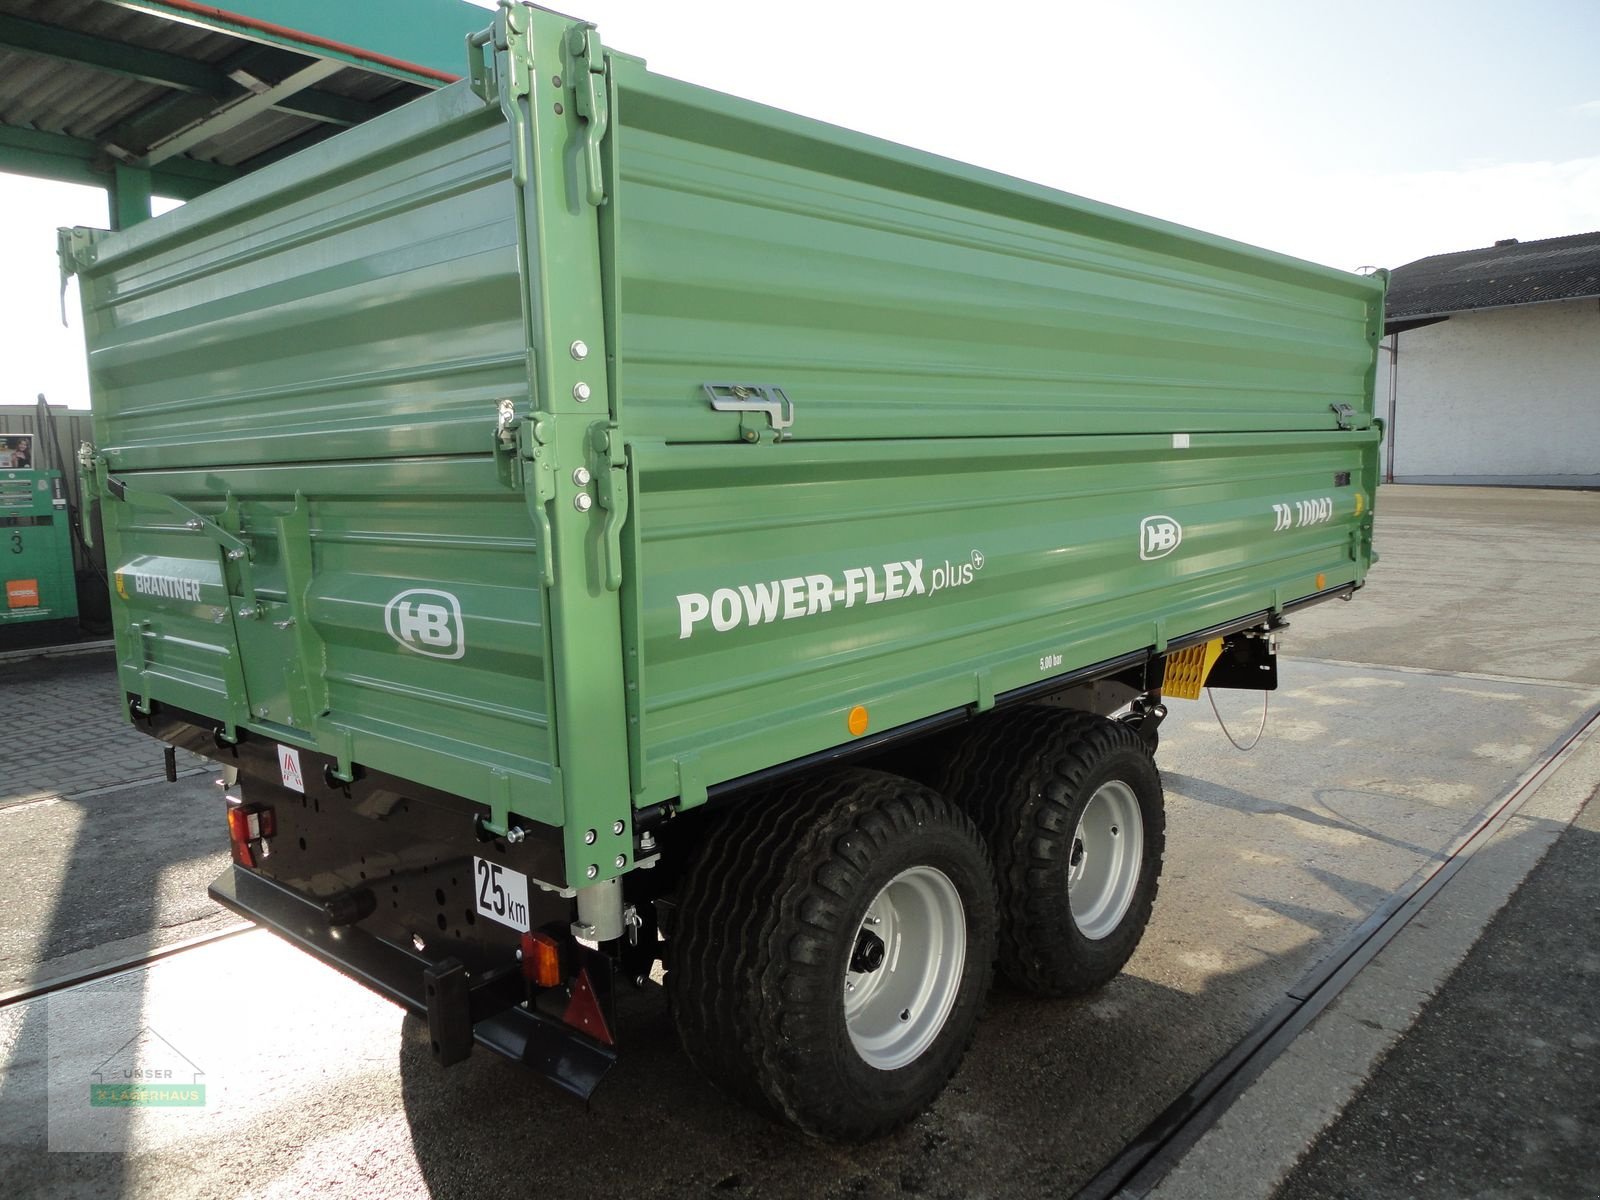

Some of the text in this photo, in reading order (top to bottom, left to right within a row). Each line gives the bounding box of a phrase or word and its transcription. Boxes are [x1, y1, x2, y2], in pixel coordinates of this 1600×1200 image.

[1272, 504, 1292, 532] TA
[11, 535, 24, 554] 3
[135, 573, 202, 602] BRANTNER
[676, 558, 926, 639] POWER-FLEX
[477, 859, 527, 926] 25 km
